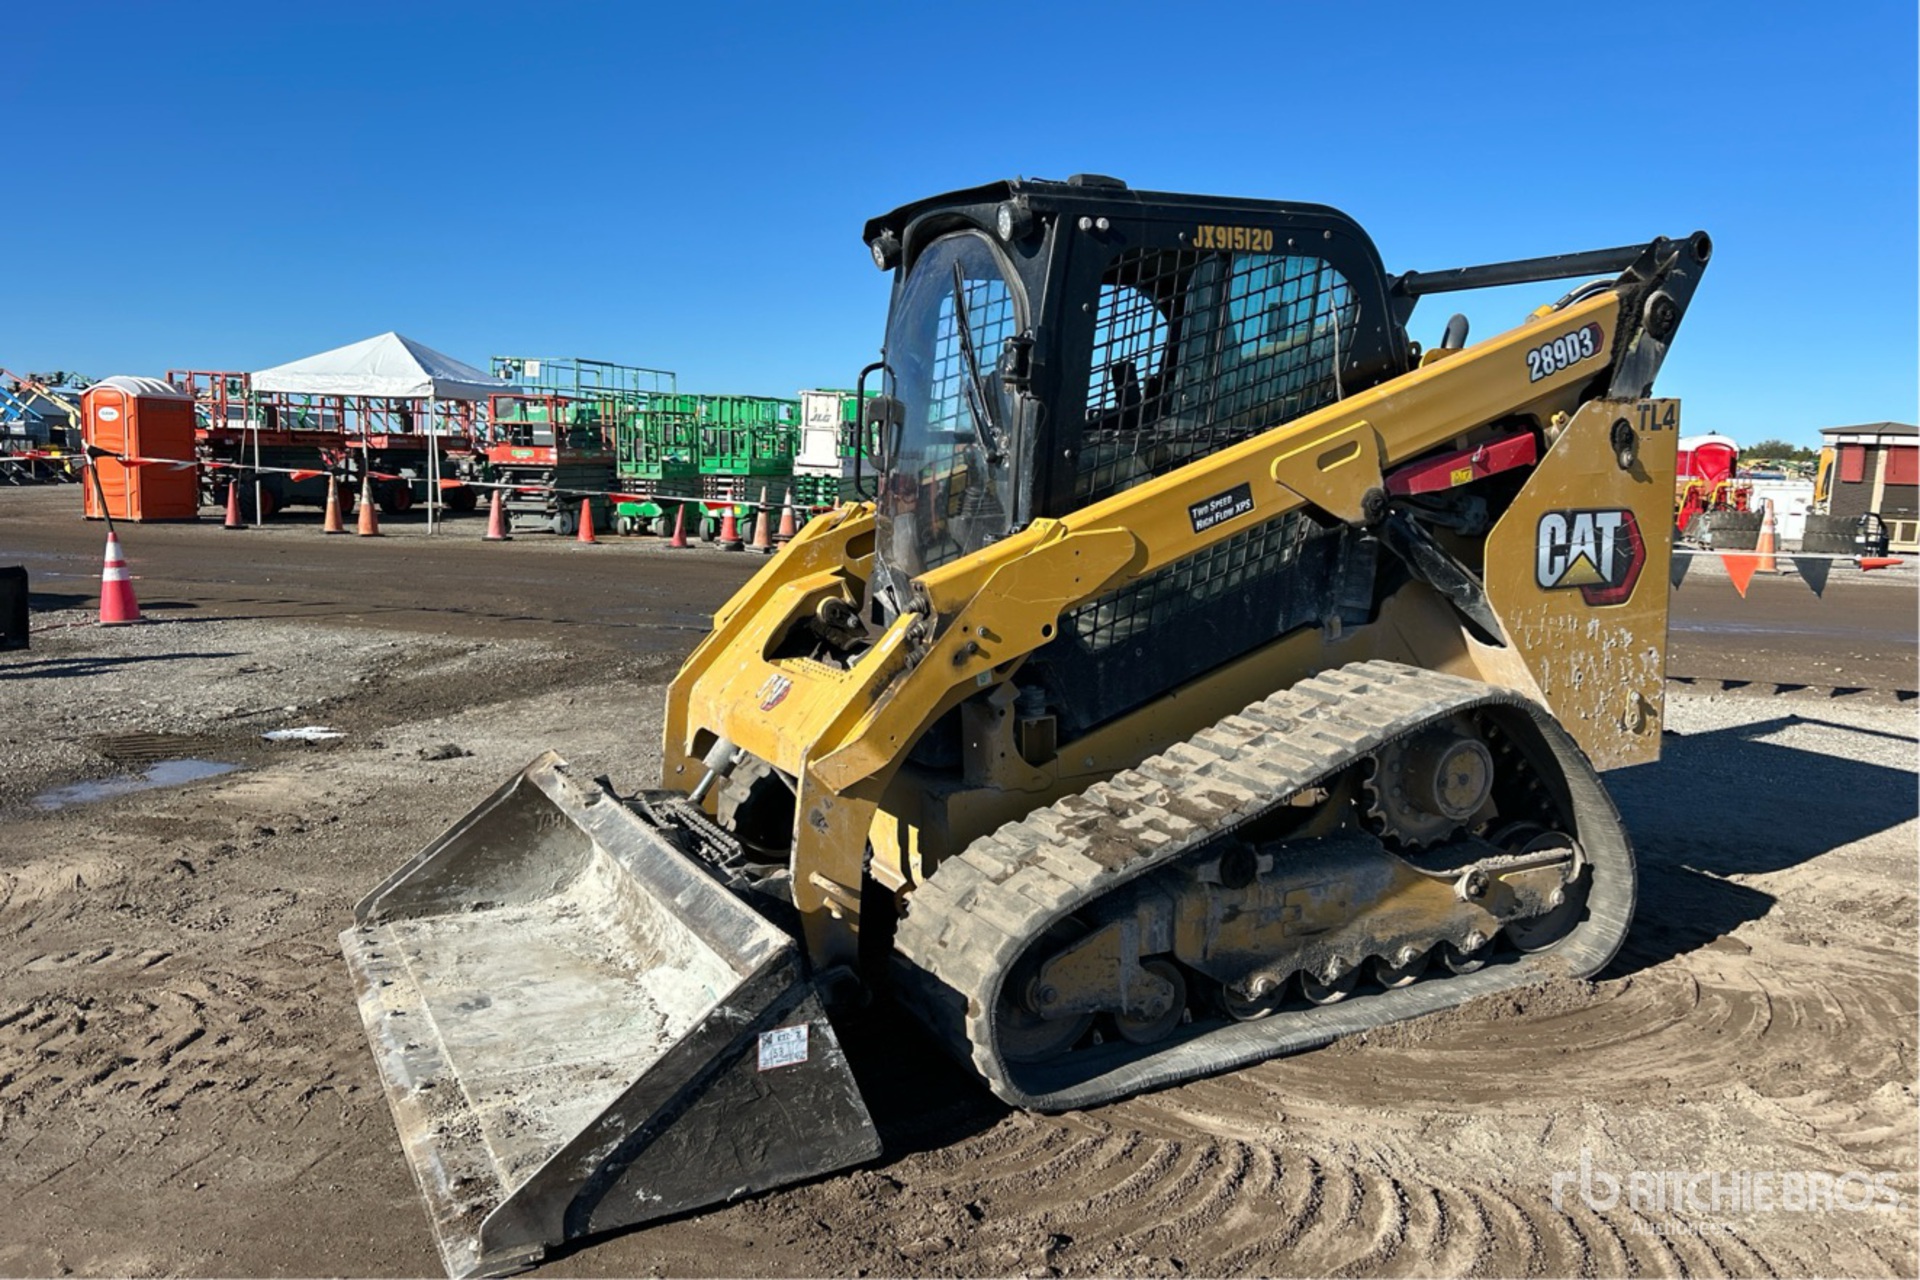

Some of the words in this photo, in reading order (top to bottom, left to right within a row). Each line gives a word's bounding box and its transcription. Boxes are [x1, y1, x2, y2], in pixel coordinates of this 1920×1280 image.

[1193, 225, 1273, 251] JX915120
[1527, 327, 1594, 381] 289D3
[1637, 404, 1675, 431] TL4
[1235, 499, 1250, 513] XPS
[1538, 512, 1622, 587] CAT
